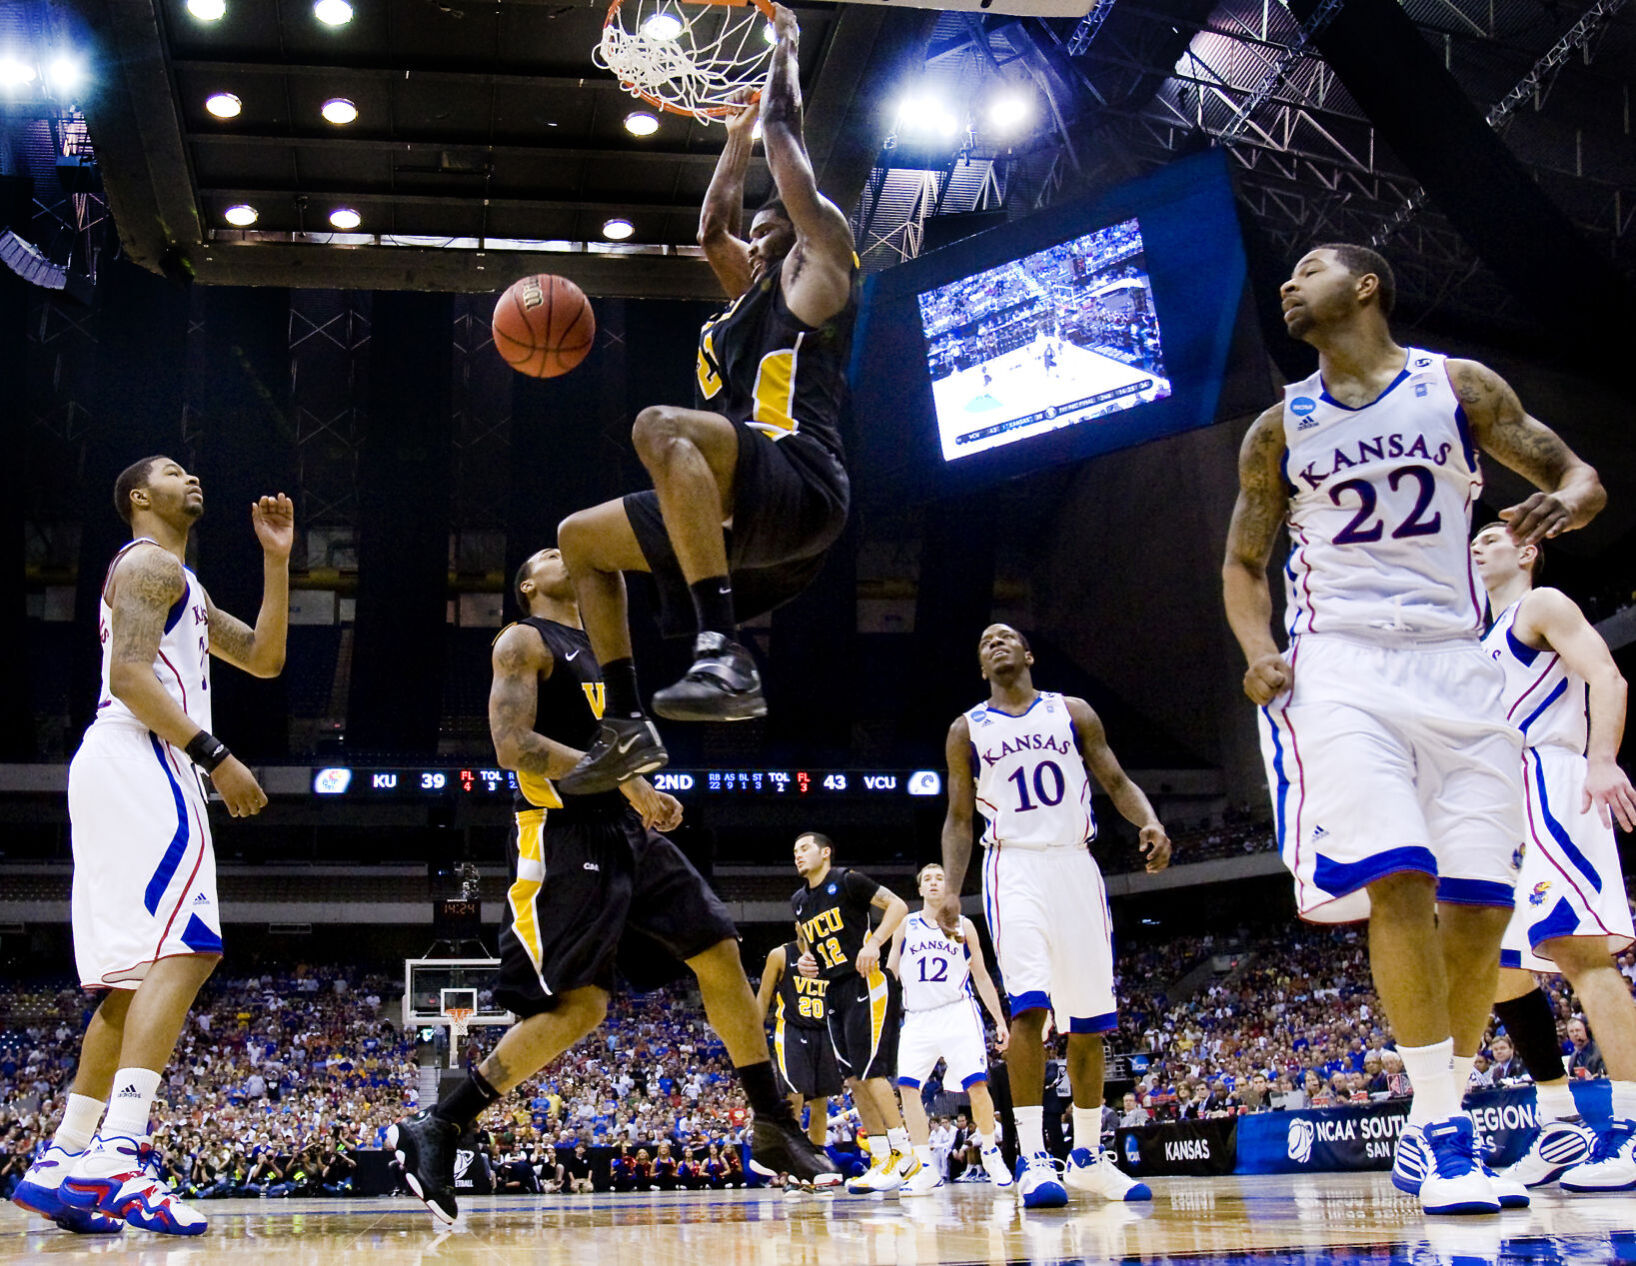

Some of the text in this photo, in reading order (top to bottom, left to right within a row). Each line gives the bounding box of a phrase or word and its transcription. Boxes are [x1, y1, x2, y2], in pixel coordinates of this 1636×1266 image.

[1299, 434, 1452, 491] KANSAS
[1328, 464, 1441, 545] 22
[982, 734, 1070, 767] KANSAS
[373, 773, 446, 789] KU 39
[461, 771, 474, 781] FL
[480, 771, 502, 781] TOL
[508, 771, 515, 780] R
[654, 774, 693, 790] 2ND
[709, 773, 763, 782] RB AS BL ST
[768, 772, 790, 782] TOL
[797, 772, 811, 782] FL
[823, 774, 896, 790] 43 VCU
[464, 782, 471, 791] 4
[488, 782, 496, 791] 3
[709, 781, 761, 790] 22 9 1 3
[777, 783, 784, 792] 2
[800, 783, 807, 792] 3
[1008, 760, 1065, 812] 10
[444, 903, 475, 914] 14:24
[802, 907, 844, 944] VCU
[816, 937, 848, 970] 12
[909, 941, 959, 956] KANSAS
[916, 956, 948, 982] 12
[793, 976, 830, 997] VCU
[798, 997, 824, 1019] 20
[1165, 1139, 1210, 1161] KANSAS
[1366, 1141, 1391, 1158] SAN
